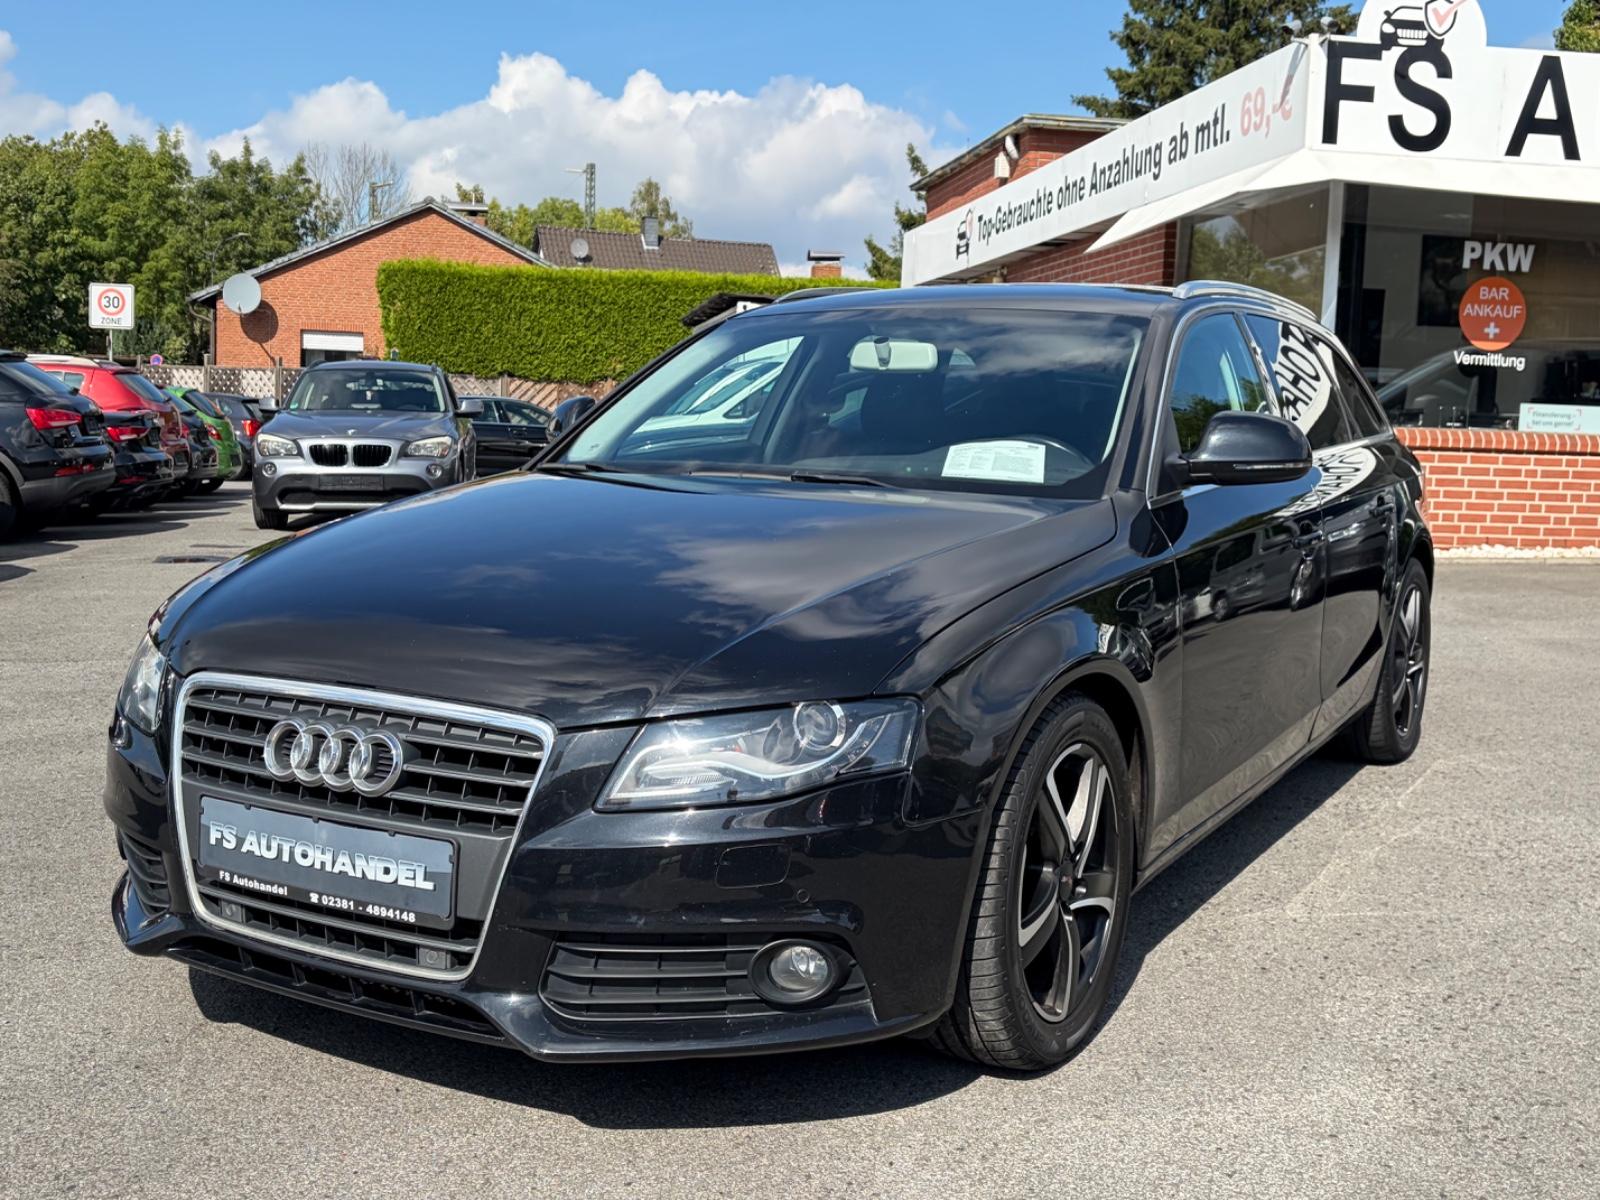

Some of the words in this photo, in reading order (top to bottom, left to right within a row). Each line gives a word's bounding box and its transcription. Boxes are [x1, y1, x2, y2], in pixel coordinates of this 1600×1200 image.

[1322, 40, 1453, 152] FS
[1504, 55, 1581, 161] A
[977, 186, 1053, 246] Top-Gebrauchte
[1057, 175, 1086, 210] ohne
[1088, 142, 1163, 197] Anzahlung
[1168, 121, 1189, 165] ab
[1194, 103, 1230, 154] mtl.
[1462, 240, 1535, 272] PKW
[103, 295, 120, 309] 30
[1479, 286, 1509, 300] BAR
[100, 317, 122, 325] ZONE
[1463, 303, 1523, 318] ANKAUF
[1453, 350, 1526, 371] Vermittlung
[209, 821, 237, 850] FS
[241, 830, 435, 891] AUTOHANDEL
[219, 870, 231, 882] FS
[233, 875, 288, 896] Autohandel
[321, 895, 354, 910] 02381
[366, 904, 416, 922] 4894148
